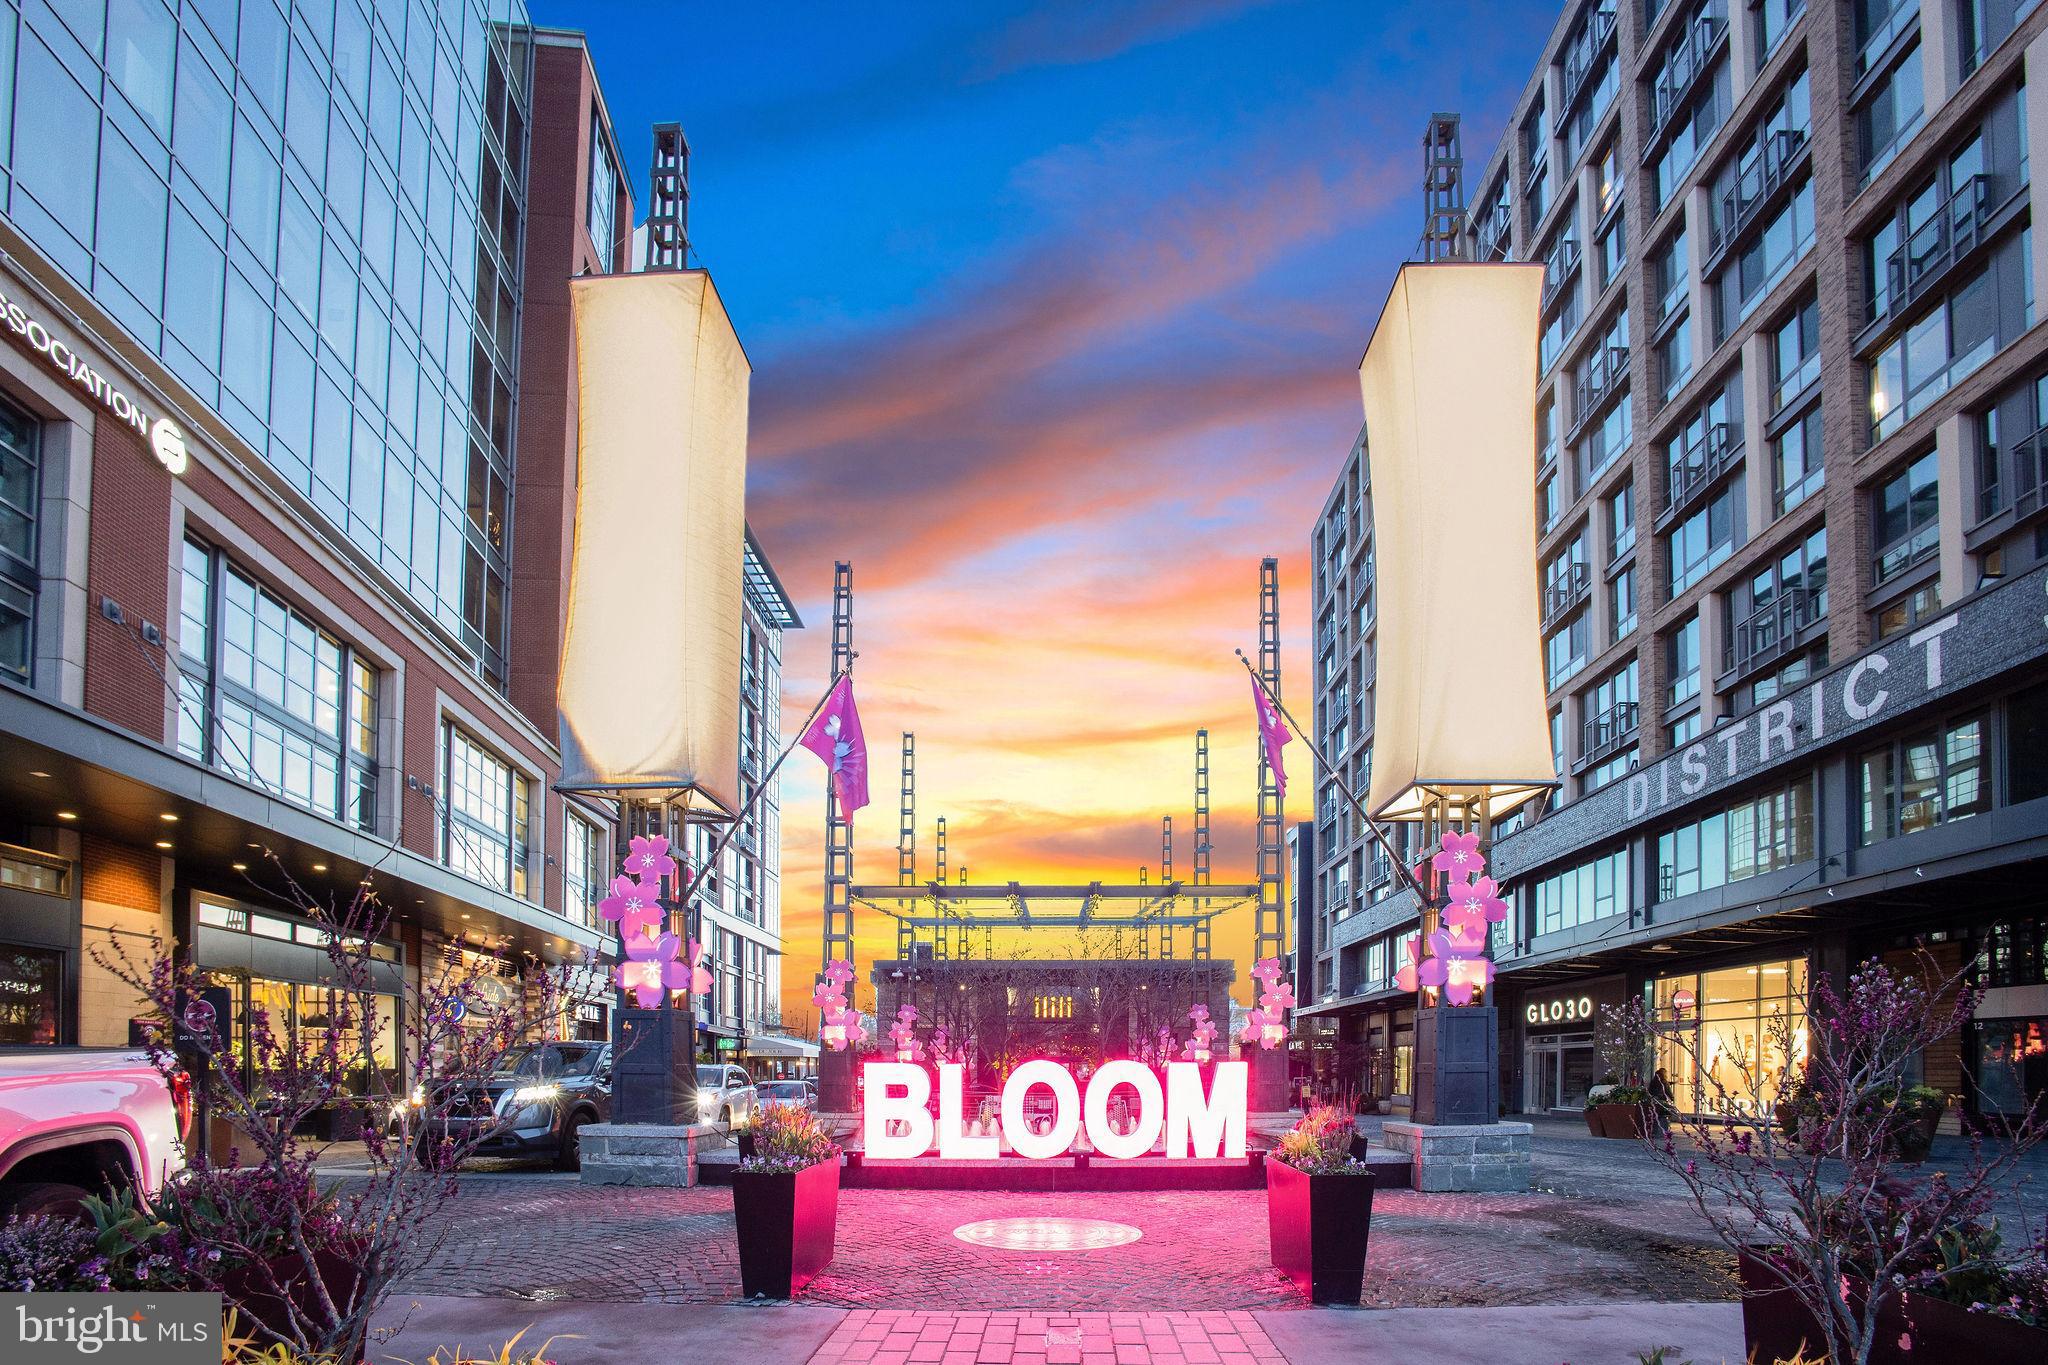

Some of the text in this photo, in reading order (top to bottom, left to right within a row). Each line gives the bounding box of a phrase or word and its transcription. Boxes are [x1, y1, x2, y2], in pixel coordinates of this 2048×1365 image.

[1626, 613, 1959, 822] DISTRICT
[1034, 996, 1072, 1018] ilili
[863, 1059, 1249, 1160] BLOOM
